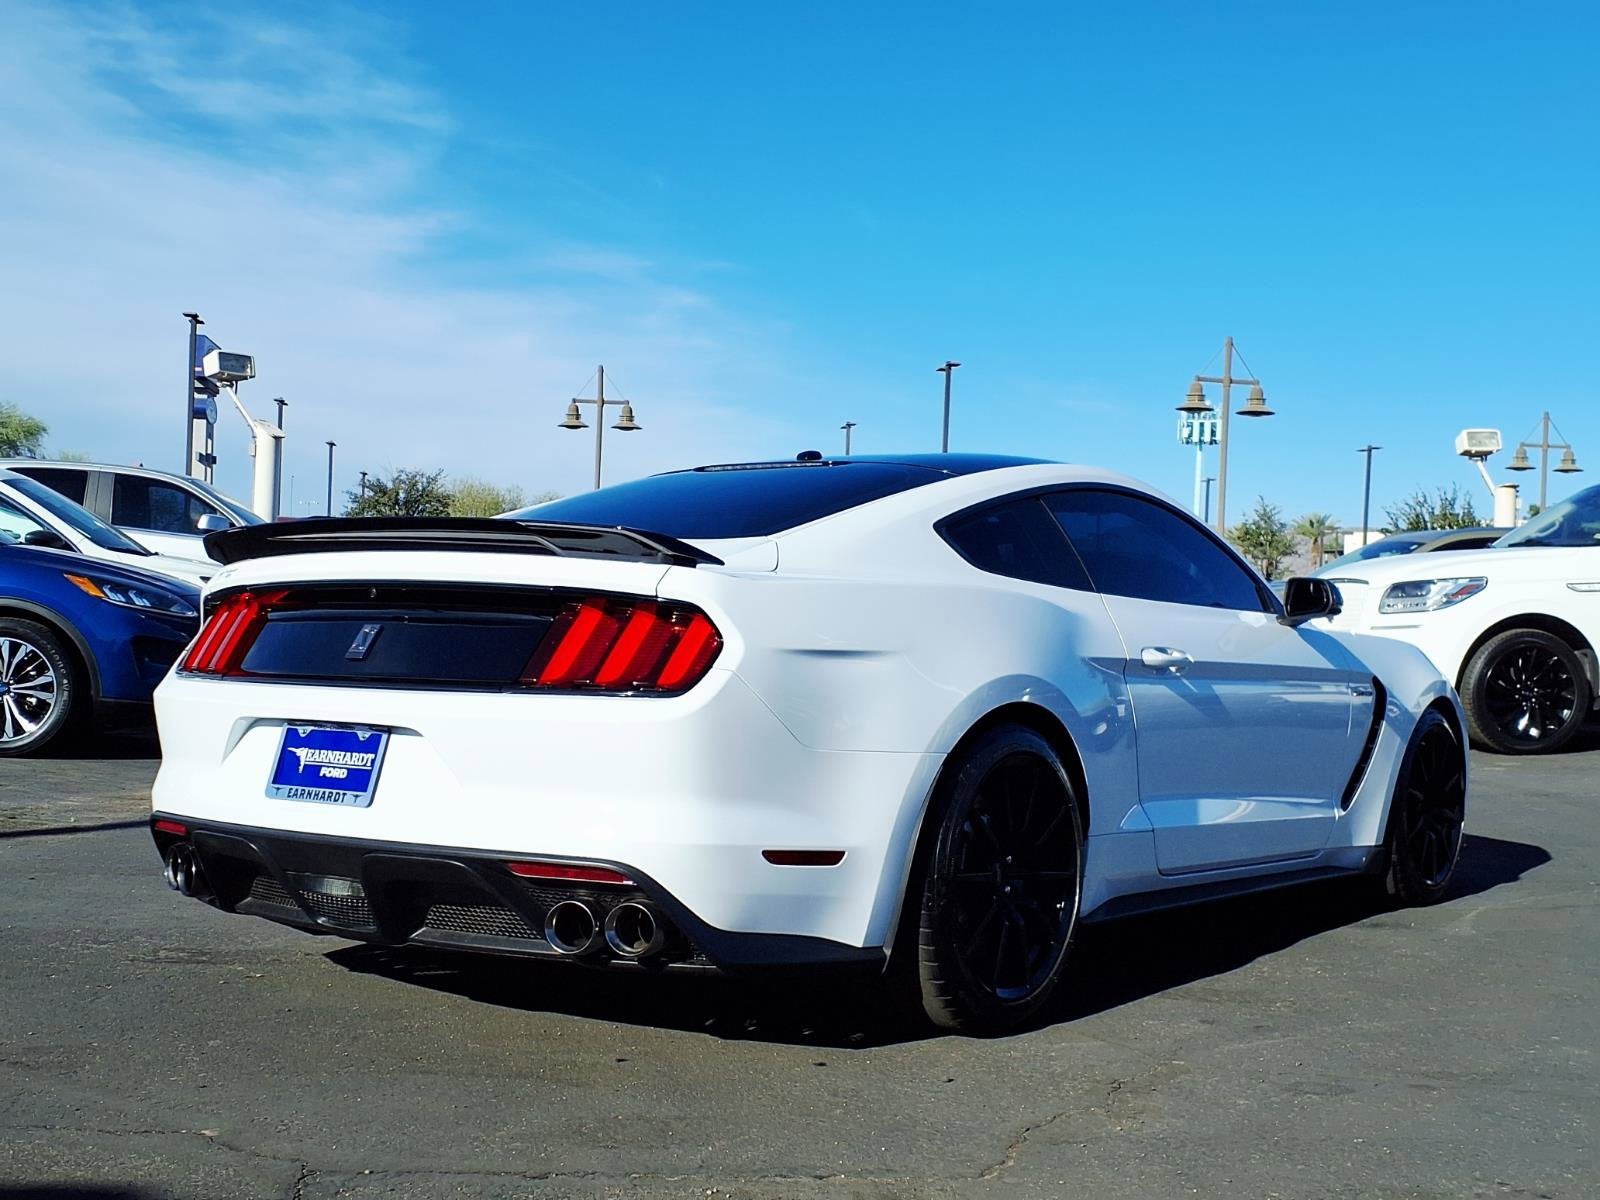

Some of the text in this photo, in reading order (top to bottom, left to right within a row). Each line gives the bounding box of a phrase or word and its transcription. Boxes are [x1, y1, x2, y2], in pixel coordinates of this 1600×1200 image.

[306, 749, 375, 767] EARNHARDT
[320, 767, 347, 779] FORD
[286, 787, 347, 803] EARNHARDT
